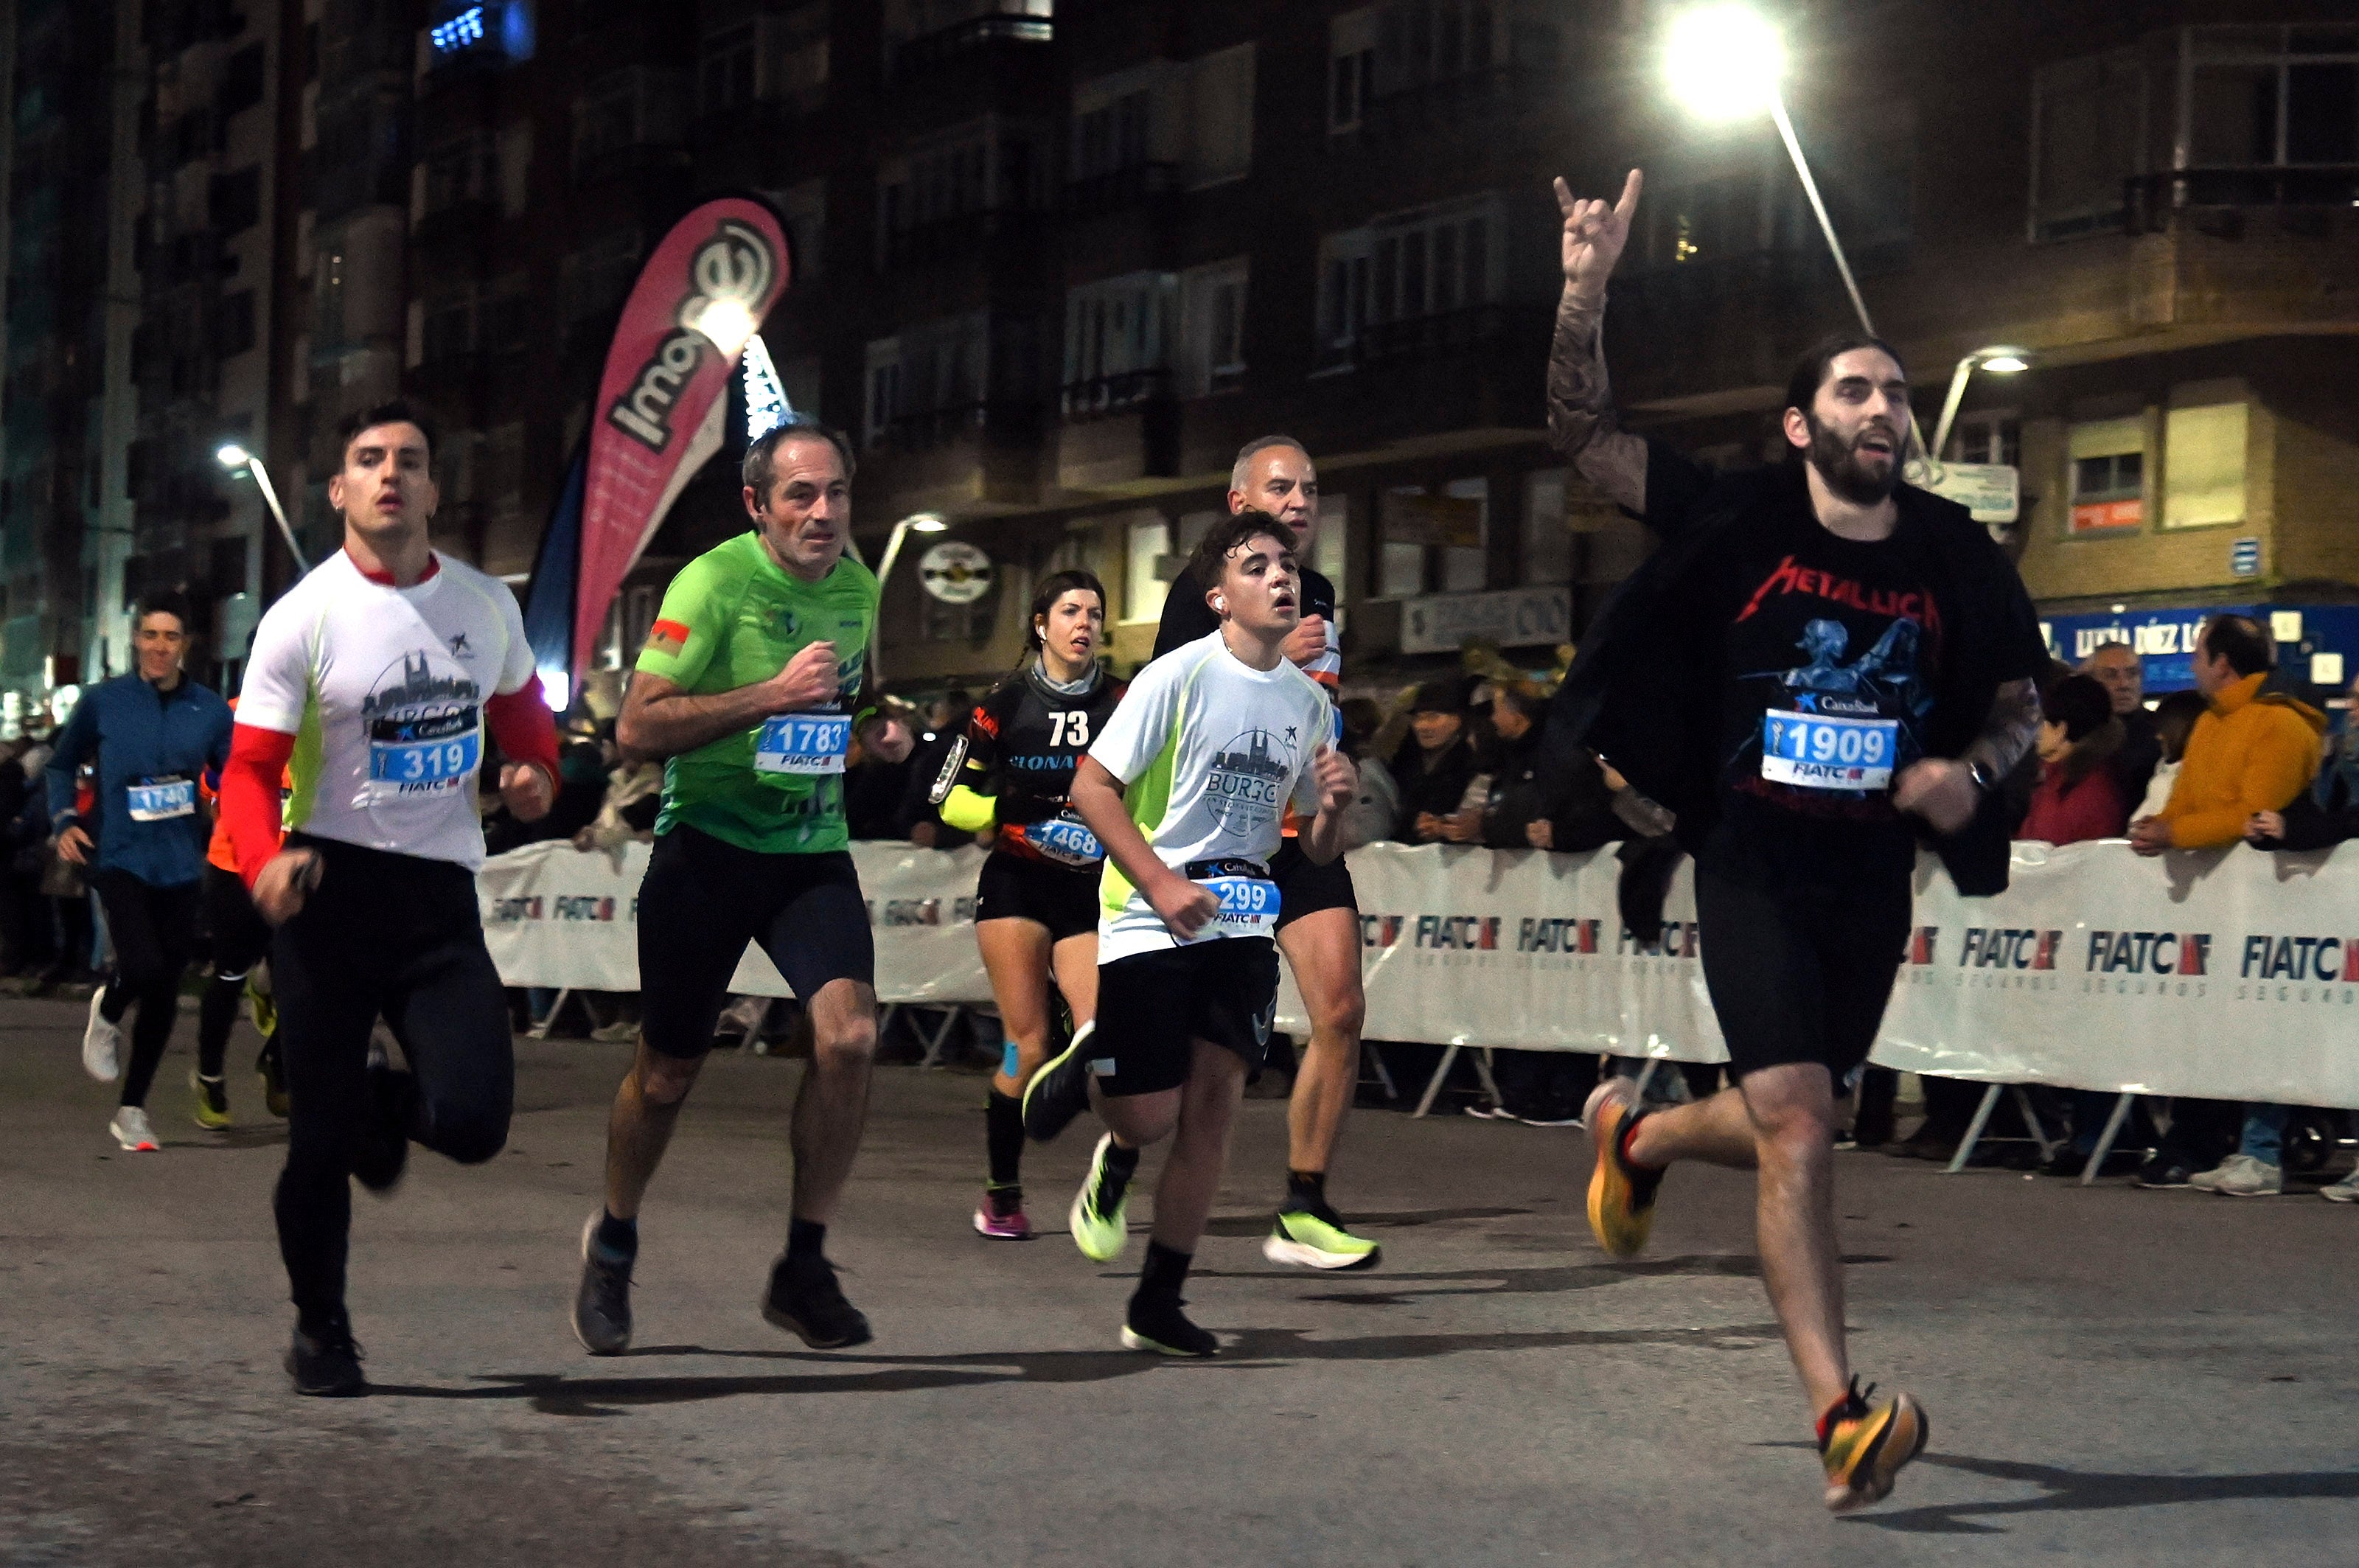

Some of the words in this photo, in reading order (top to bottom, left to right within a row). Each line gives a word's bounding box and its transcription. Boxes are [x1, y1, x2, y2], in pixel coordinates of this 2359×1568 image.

[778, 722, 842, 753] 1783
[1048, 710, 1089, 747] 73
[1789, 723, 1885, 764] 1909
[404, 743, 464, 780] 319
[1042, 825, 1097, 854] 1468
[1959, 927, 2036, 969] FIATC
[2086, 930, 2178, 975] FIATC
[2240, 935, 2341, 981] FIATC
